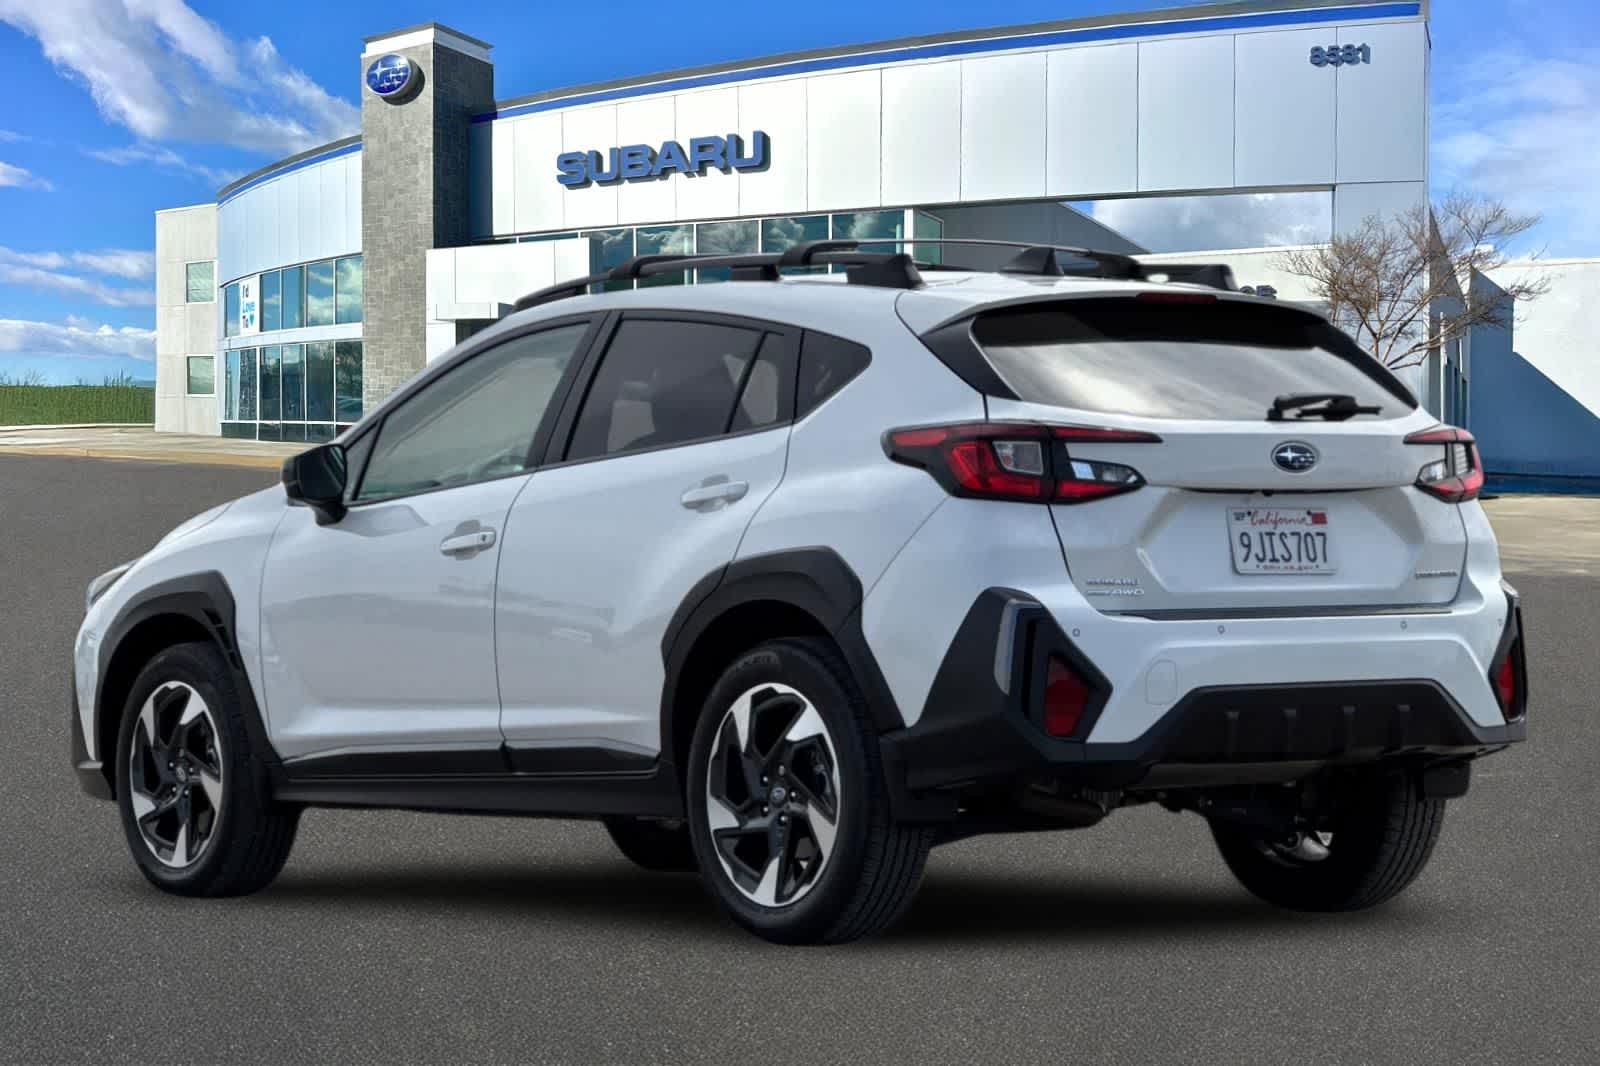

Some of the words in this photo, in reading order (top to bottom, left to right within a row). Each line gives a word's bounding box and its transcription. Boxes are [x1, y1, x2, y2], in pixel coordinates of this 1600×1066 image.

[556, 130, 771, 190] SUBARU
[1250, 510, 1307, 530] California
[1240, 531, 1328, 563] 9JIS707
